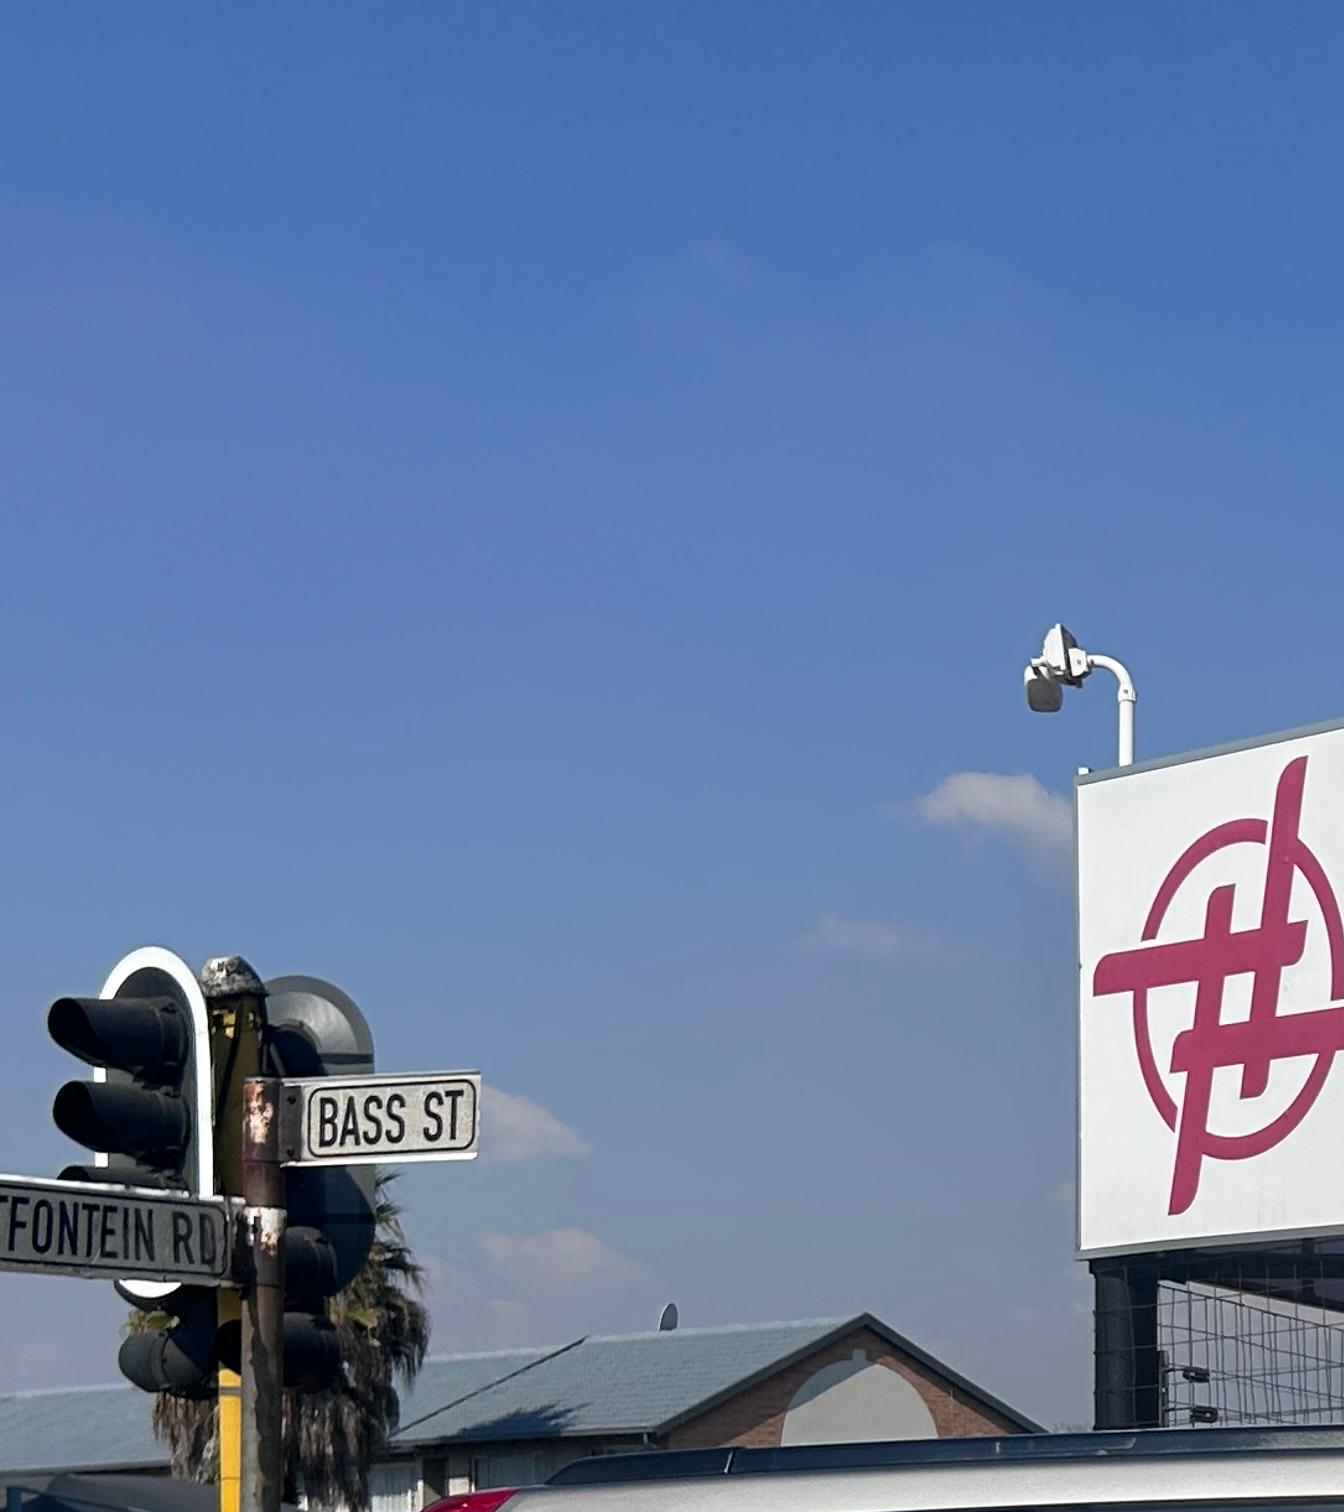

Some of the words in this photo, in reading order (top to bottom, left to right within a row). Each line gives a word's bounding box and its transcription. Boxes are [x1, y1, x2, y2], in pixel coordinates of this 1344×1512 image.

[318, 1093, 407, 1148] BASS
[422, 1089, 465, 1143] ST
[0, 1195, 155, 1262] FONTEIN
[171, 1211, 217, 1268] RD
